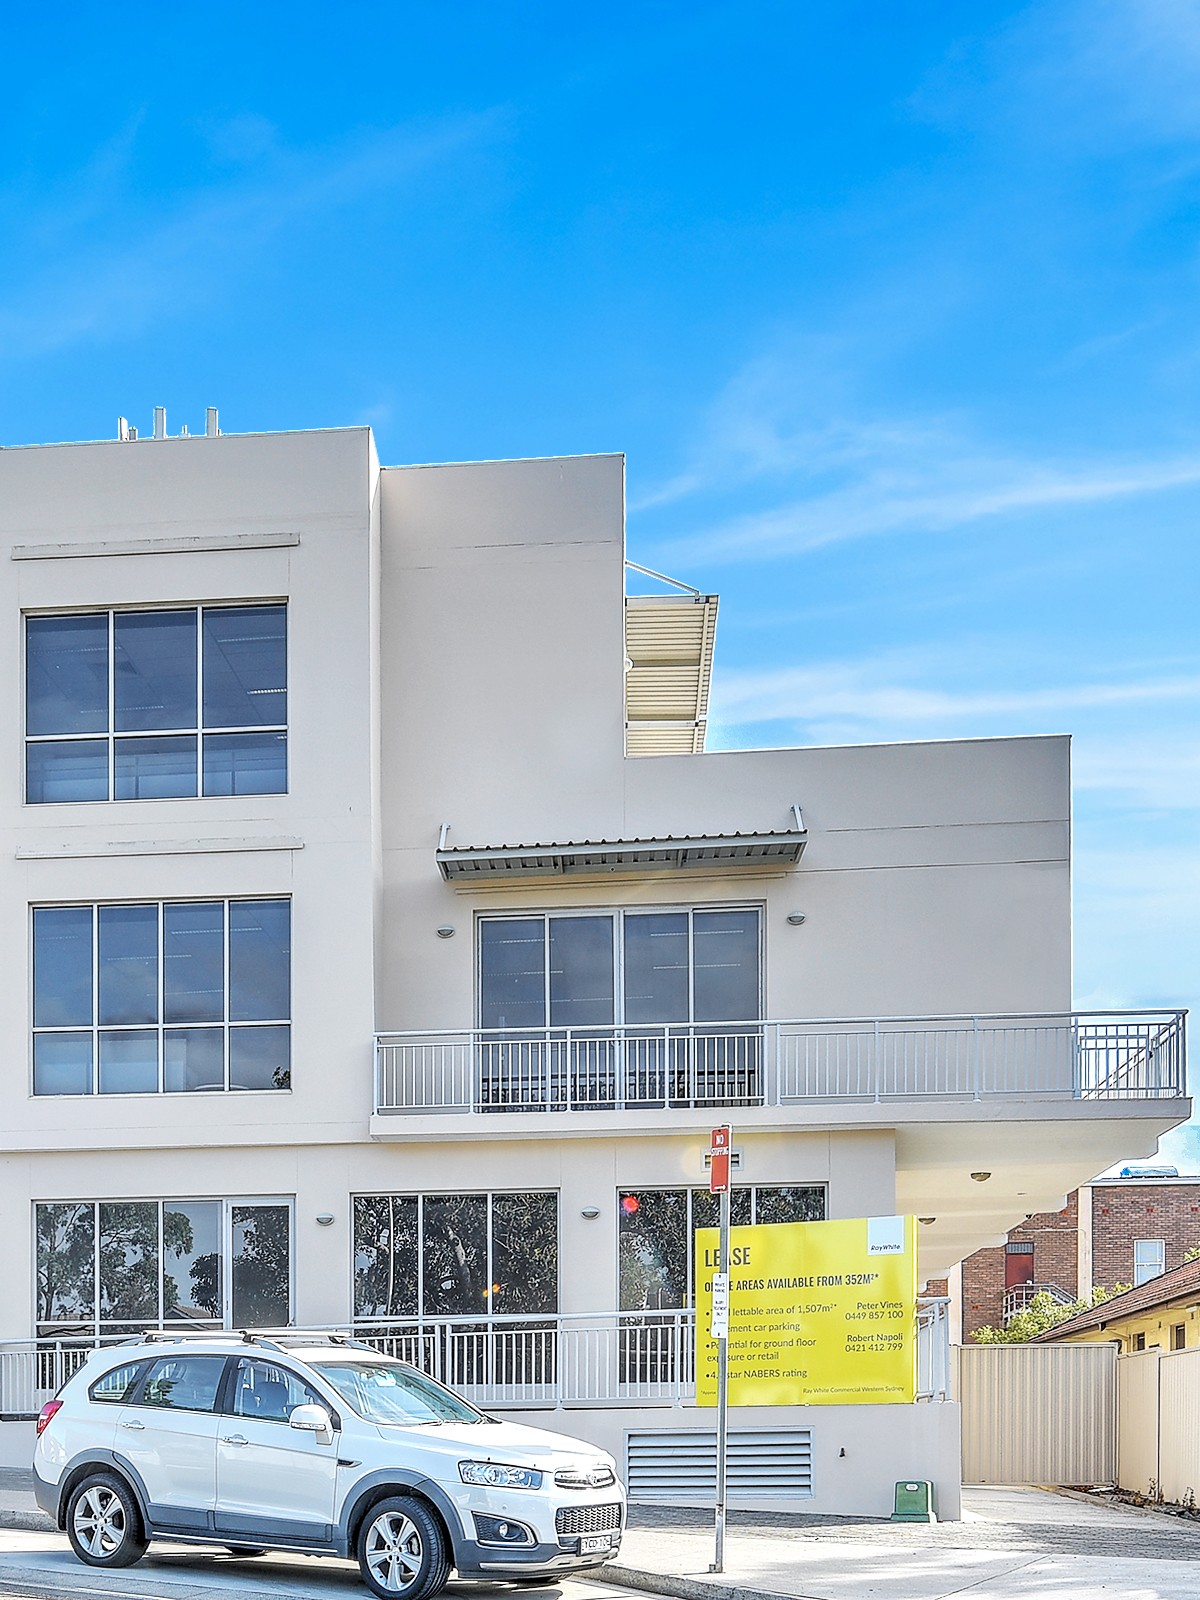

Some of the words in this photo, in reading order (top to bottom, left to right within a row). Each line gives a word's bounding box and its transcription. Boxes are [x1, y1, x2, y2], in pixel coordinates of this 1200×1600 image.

[705, 1247, 751, 1268] LESE
[736, 1279, 765, 1291] AREAS
[767, 1276, 814, 1290] AVAILABLE
[816, 1275, 843, 1287] FROM
[732, 1307, 764, 1316] lettable
[765, 1307, 784, 1315] area
[786, 1305, 795, 1314] of
[856, 1302, 879, 1310] Peter
[879, 1301, 903, 1309] Vines
[845, 1312, 867, 1321] 0449
[868, 1311, 885, 1320] 857
[887, 1310, 904, 1319] 100
[768, 1321, 801, 1333] parking
[749, 1340, 762, 1348] for
[763, 1338, 795, 1349] ground
[796, 1337, 817, 1347] floor
[846, 1334, 875, 1343] Robert
[876, 1332, 904, 1342] Napoli
[844, 1343, 867, 1353] 0421
[868, 1343, 885, 1352] 412
[887, 1342, 904, 1351] 799
[757, 1351, 779, 1361] retail
[743, 1369, 780, 1378] NABERS
[782, 1368, 808, 1378] rating
